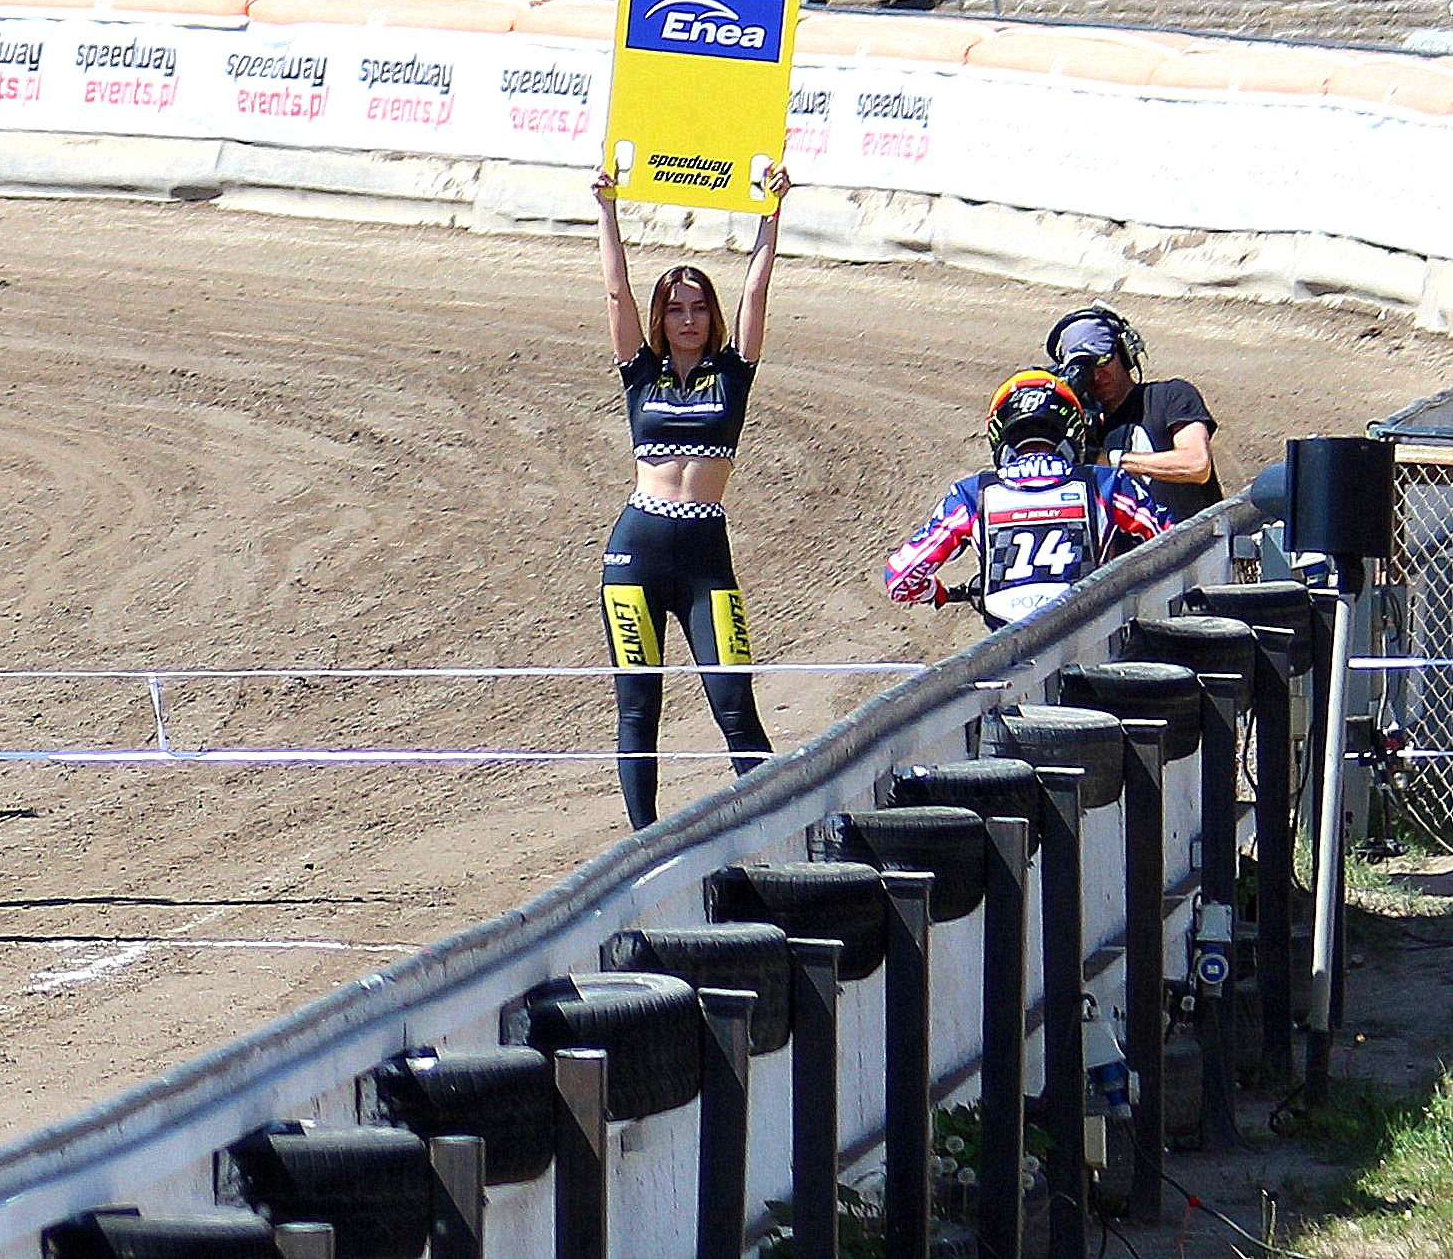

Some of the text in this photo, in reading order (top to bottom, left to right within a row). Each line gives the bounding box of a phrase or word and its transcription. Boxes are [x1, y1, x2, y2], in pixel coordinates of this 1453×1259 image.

[661, 11, 766, 50] Enea
[76, 35, 178, 77] speedway
[225, 51, 328, 87] speedway
[359, 52, 455, 95] speedway
[84, 73, 181, 112] events.pl
[237, 83, 331, 123] events.pl
[648, 152, 734, 176] speedway
[653, 170, 732, 191] events.pl
[1004, 530, 1076, 581] 14
